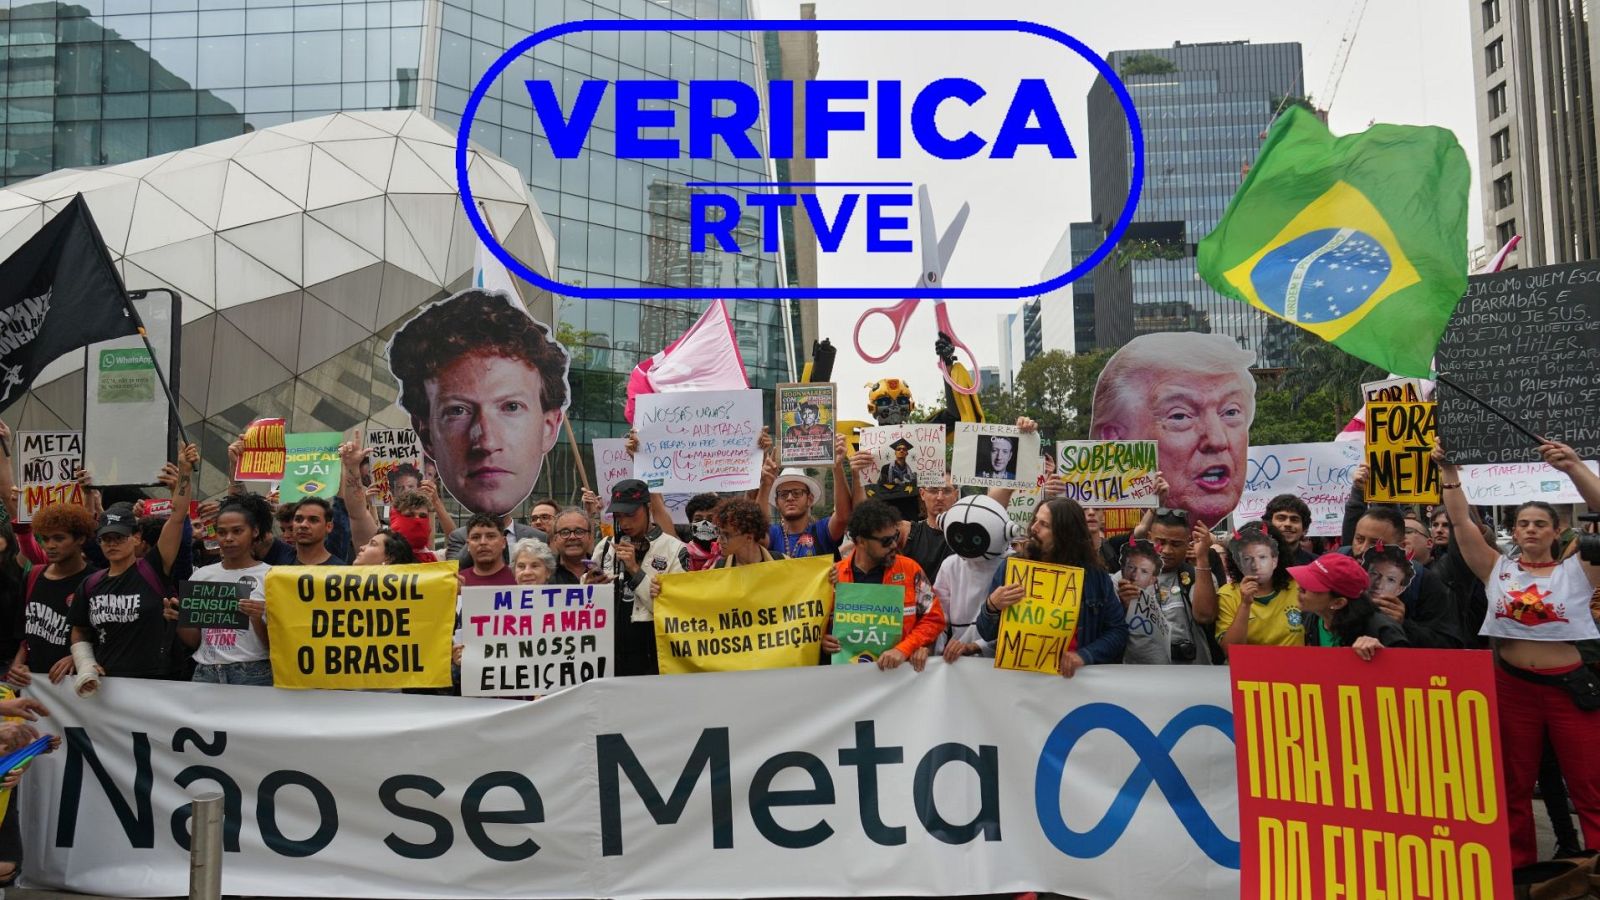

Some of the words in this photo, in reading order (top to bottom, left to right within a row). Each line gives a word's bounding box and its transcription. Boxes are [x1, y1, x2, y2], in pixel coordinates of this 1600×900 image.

[1525, 271, 1564, 289] QUEM
[1556, 290, 1571, 302] E
[1490, 344, 1511, 355] EM
[1371, 404, 1439, 446] FORA
[1520, 409, 1543, 420] QUE
[370, 431, 396, 445] META
[397, 429, 417, 444] NÃO
[963, 424, 1020, 434] ZUKERBE
[24, 434, 81, 453] META
[373, 446, 387, 458] SE
[390, 445, 420, 459] META
[24, 457, 54, 482] NÃO
[294, 461, 329, 475] JÁ!
[1059, 441, 1157, 474] SOBERANIA
[1370, 447, 1439, 497] META
[25, 482, 83, 515] META
[1065, 476, 1128, 502] DIGITAL
[193, 585, 215, 597] FIM
[218, 586, 236, 598] DA
[298, 574, 314, 602] O
[325, 573, 423, 601] BRASIL
[1012, 564, 1077, 607] META
[181, 598, 239, 610] CENSUR
[494, 586, 593, 610] META!
[836, 603, 901, 613] SOBERANIA
[191, 611, 239, 624] DIGITAL
[312, 608, 410, 638] DECIDE
[471, 615, 532, 637] TIRA
[543, 613, 555, 633] A
[561, 603, 606, 631] MÃO
[664, 617, 714, 633] Meta,
[719, 608, 753, 630] NÃO
[757, 607, 777, 626] SE
[782, 599, 824, 622] META
[835, 612, 900, 625] DIGITAL
[1007, 600, 1045, 625] NÃO
[1049, 609, 1075, 631] SE
[484, 643, 508, 659] DA
[519, 635, 596, 657] NOSSA
[670, 640, 692, 657] NA
[697, 635, 753, 657] NOSSA
[847, 626, 886, 646] JÁ!
[298, 645, 314, 674] O
[325, 644, 424, 674] BRASIL
[480, 655, 606, 690] ELEIÇÃO!
[1237, 680, 1334, 807] TIRA
[1338, 685, 1373, 811] A
[1376, 675, 1498, 825] MÃO
[56, 726, 339, 858] Não
[378, 770, 545, 862] se
[595, 719, 1002, 857] Meta
[1258, 816, 1312, 900] DA
